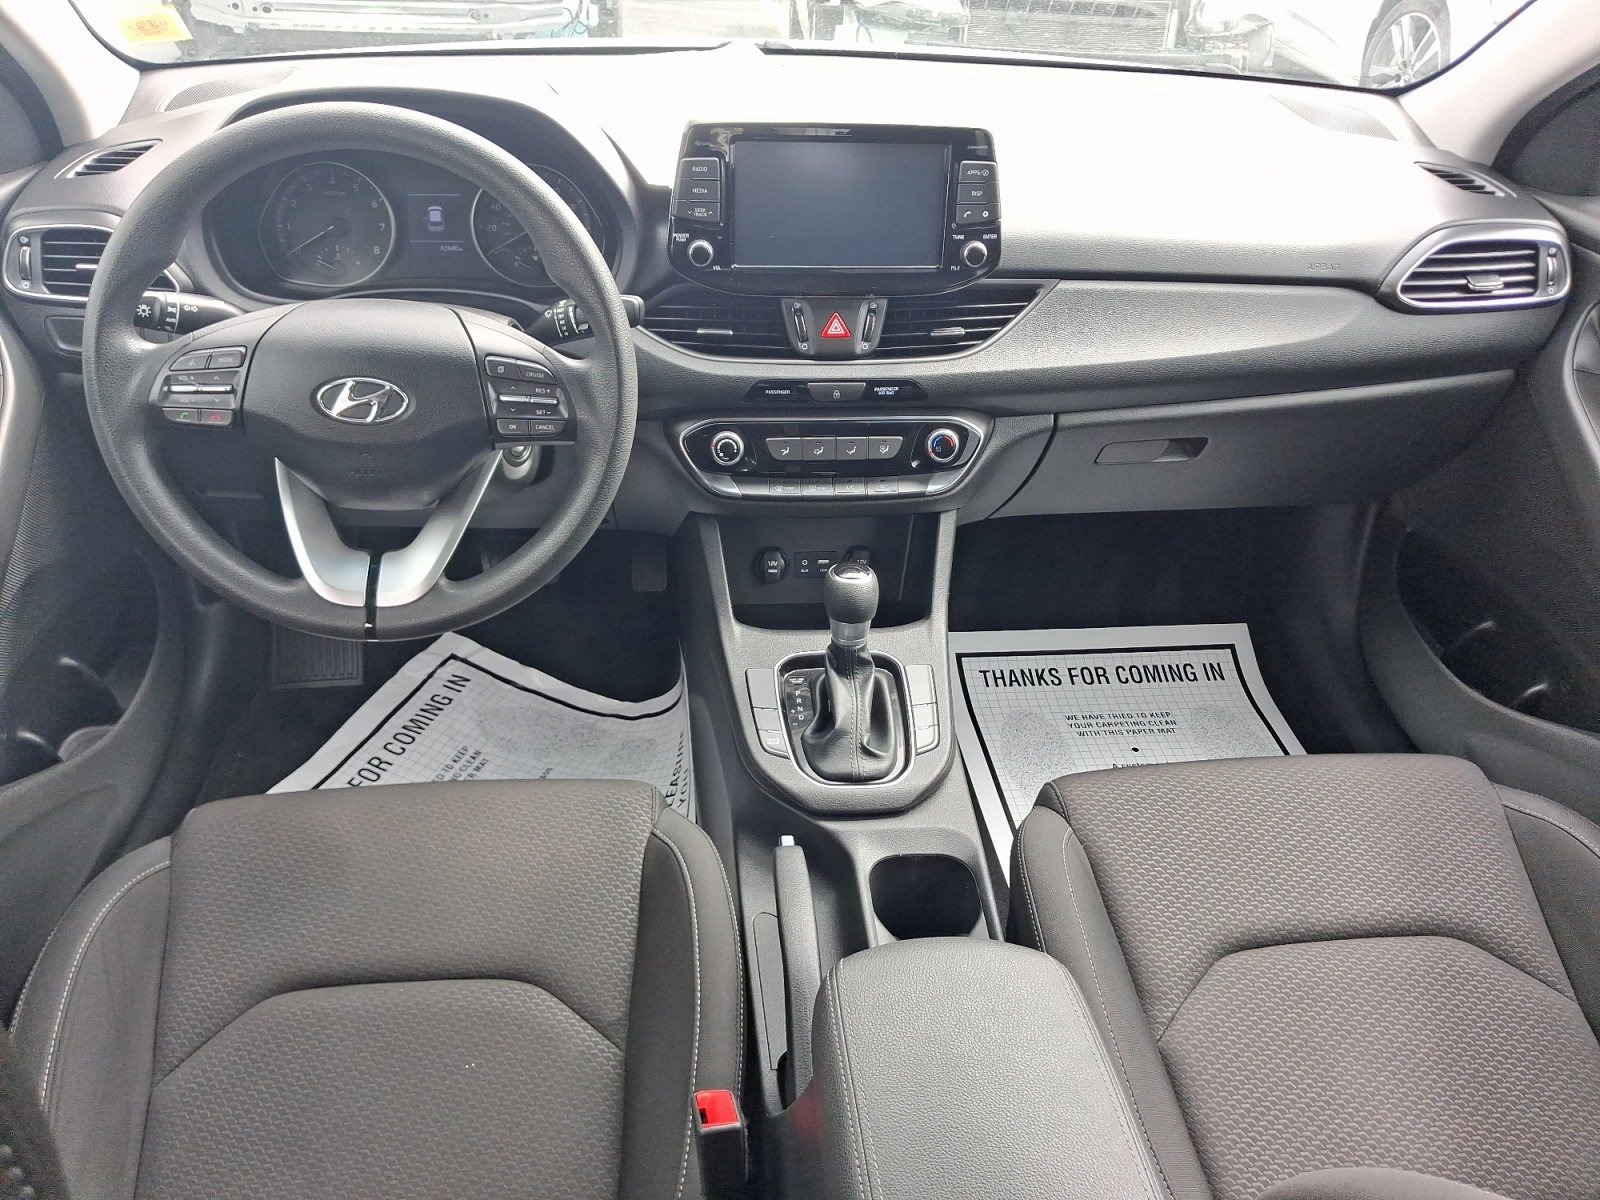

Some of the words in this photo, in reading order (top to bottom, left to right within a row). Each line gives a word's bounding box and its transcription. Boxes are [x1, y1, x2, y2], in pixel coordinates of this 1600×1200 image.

[371, 200, 378, 209] 6
[379, 223, 385, 232] 7
[373, 246, 380, 255] 8
[525, 371, 545, 379] CRUISE
[979, 667, 1063, 688] THANKS
[1067, 665, 1111, 686] FOR
[1115, 663, 1199, 684] COMING
[1202, 662, 1227, 681] IN
[1095, 720, 1147, 728] CARPETING
[347, 756, 394, 788] FOR
[383, 694, 455, 756] COMING
[442, 674, 472, 693] IN
[451, 745, 468, 764] KEEP
[459, 750, 483, 773] CLEAN
[472, 758, 490, 772] MAT
